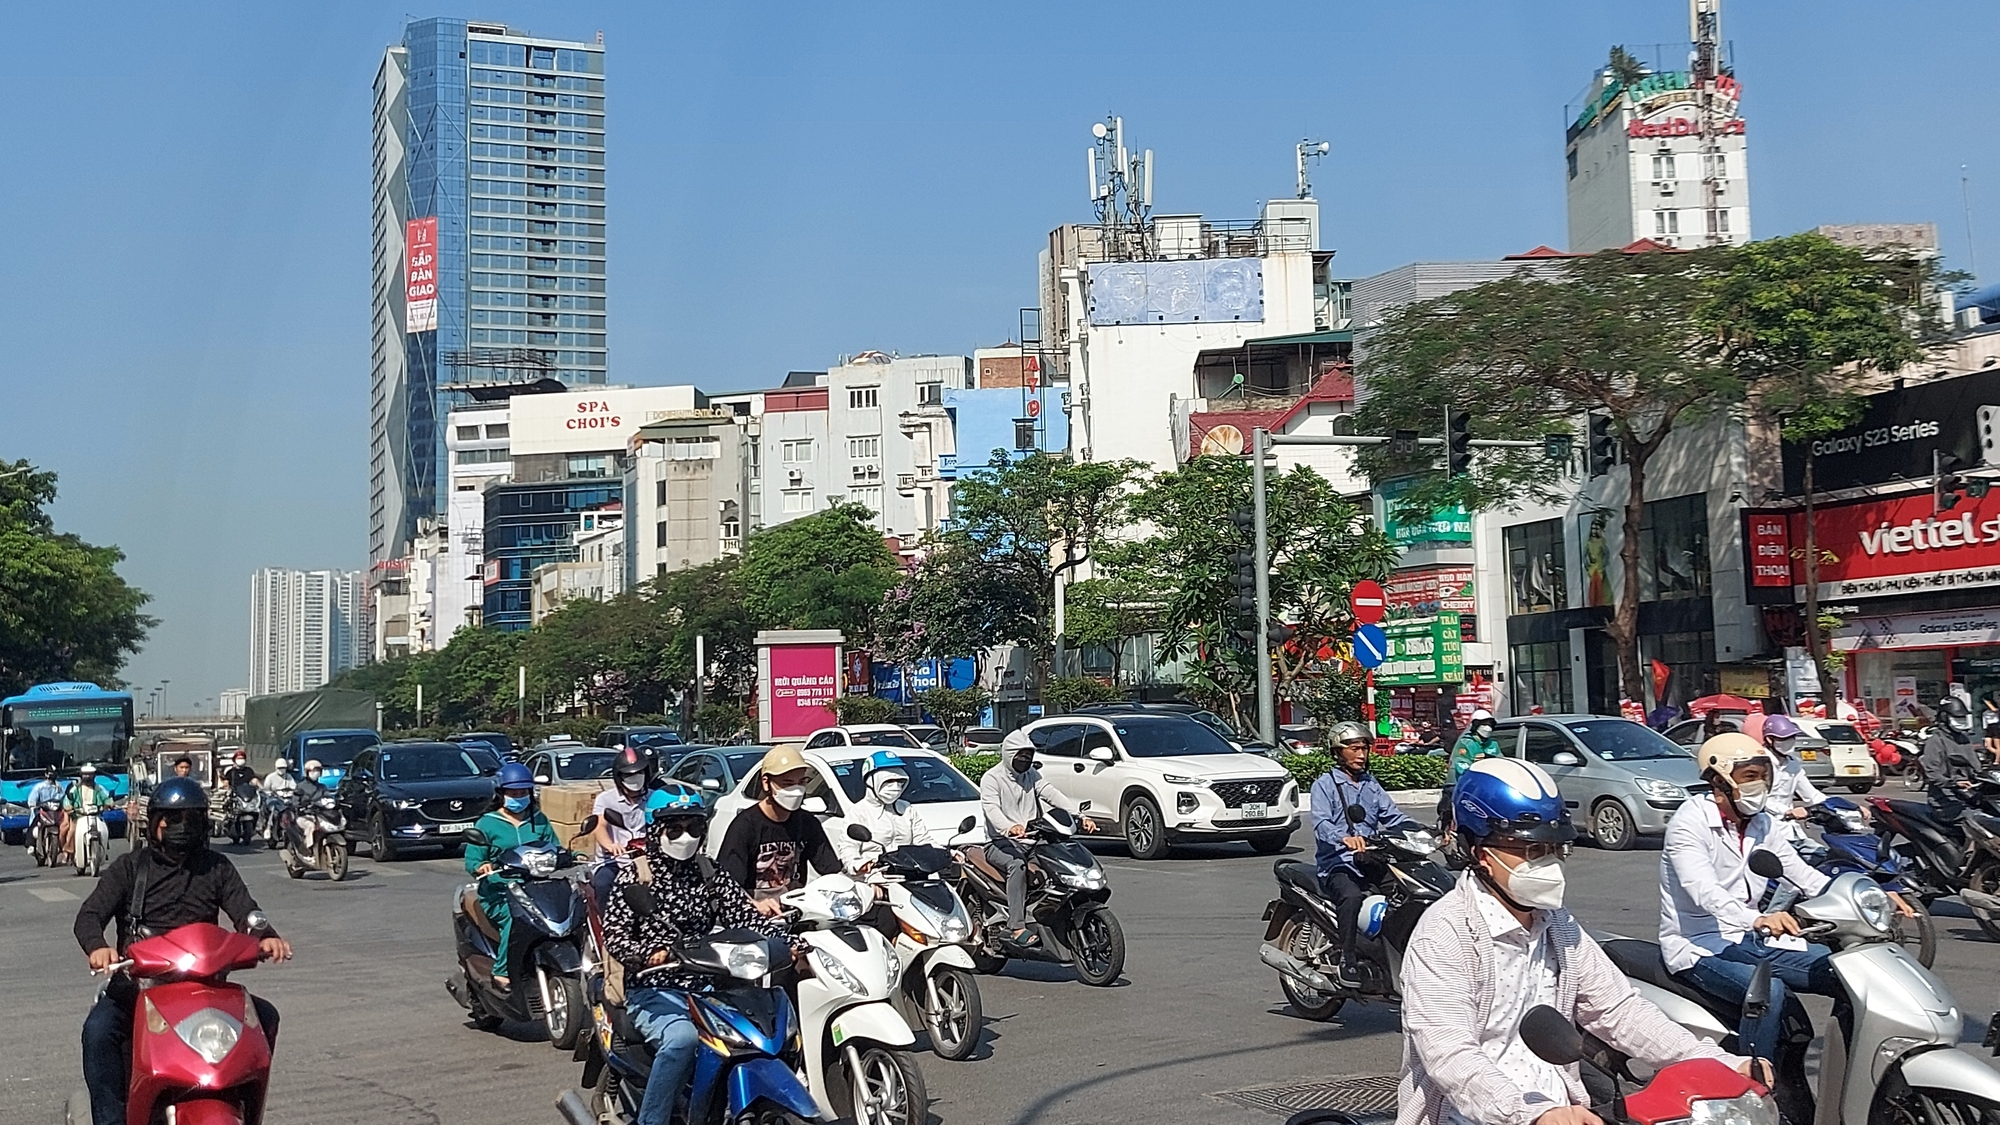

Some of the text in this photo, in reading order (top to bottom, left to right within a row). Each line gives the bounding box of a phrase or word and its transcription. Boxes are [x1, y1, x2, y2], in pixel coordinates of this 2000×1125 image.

[411, 268, 432, 282] BÀN
[409, 286, 434, 297] GIAO
[577, 401, 609, 413] SPA
[566, 416, 621, 430] CHOI'S
[1812, 419, 1939, 456] Galaxy S23 Series
[1858, 512, 1980, 555] viettel
[1755, 565, 1790, 579] THOẠI
